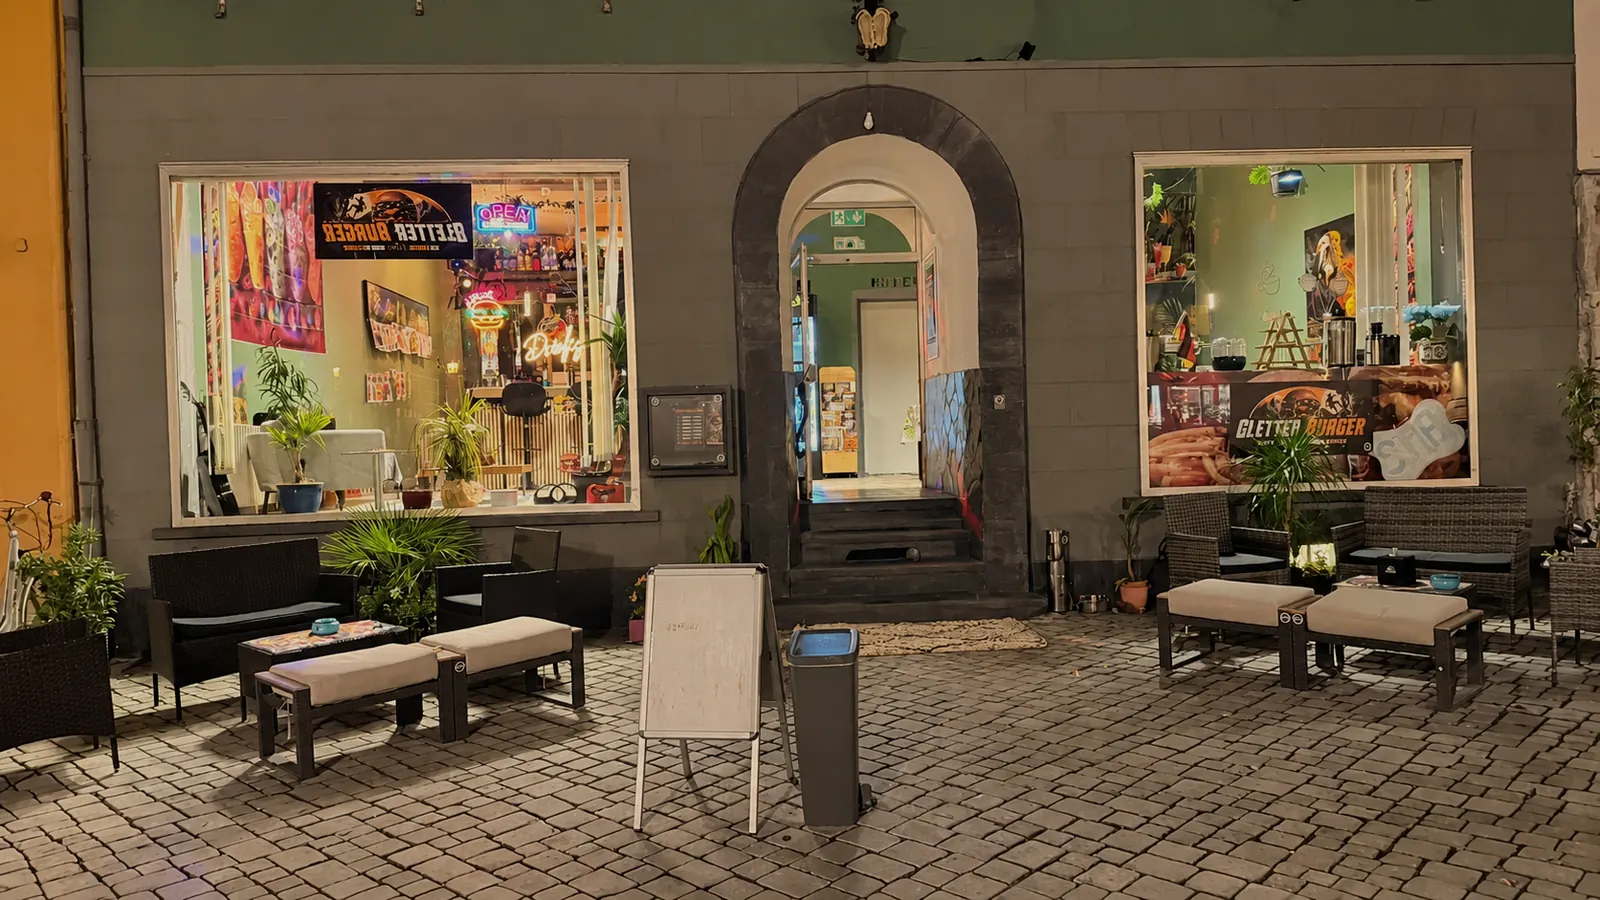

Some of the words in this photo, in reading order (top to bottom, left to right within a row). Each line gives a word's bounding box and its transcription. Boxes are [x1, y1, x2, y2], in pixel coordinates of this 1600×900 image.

[480, 204, 531, 222] OPEN
[1235, 419, 1301, 439] GLETTER
[1305, 417, 1367, 436] BURGER
